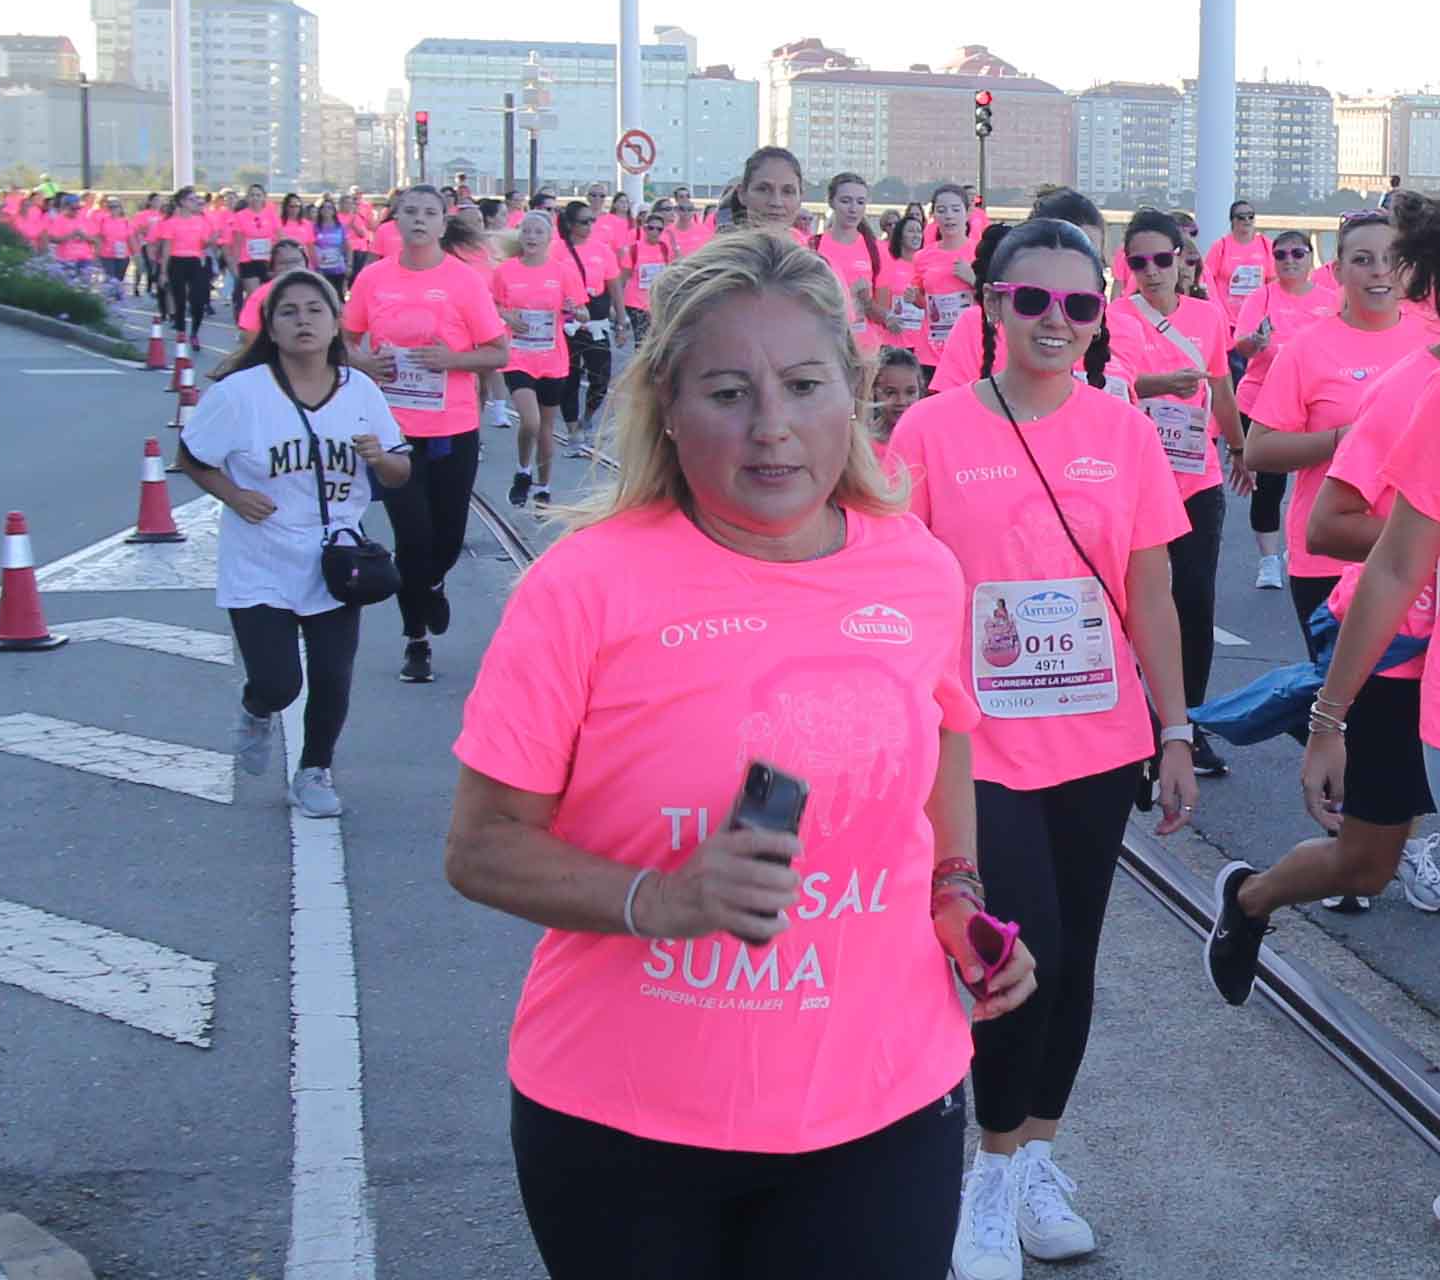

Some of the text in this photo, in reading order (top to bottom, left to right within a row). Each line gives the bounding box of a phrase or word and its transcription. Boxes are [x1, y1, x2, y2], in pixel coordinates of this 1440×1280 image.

[956, 465, 1017, 485] OYSHO
[661, 616, 767, 648] OYSHO
[1025, 633, 1074, 654] 016
[1034, 659, 1065, 671] 4971
[991, 677, 1033, 689] CARRERA
[1034, 677, 1046, 687] DE
[1048, 675, 1060, 685] LA
[990, 696, 1034, 709] OYSHO
[661, 807, 708, 851] T
[643, 935, 826, 993] SUMA
[640, 983, 697, 1008] CARRERA
